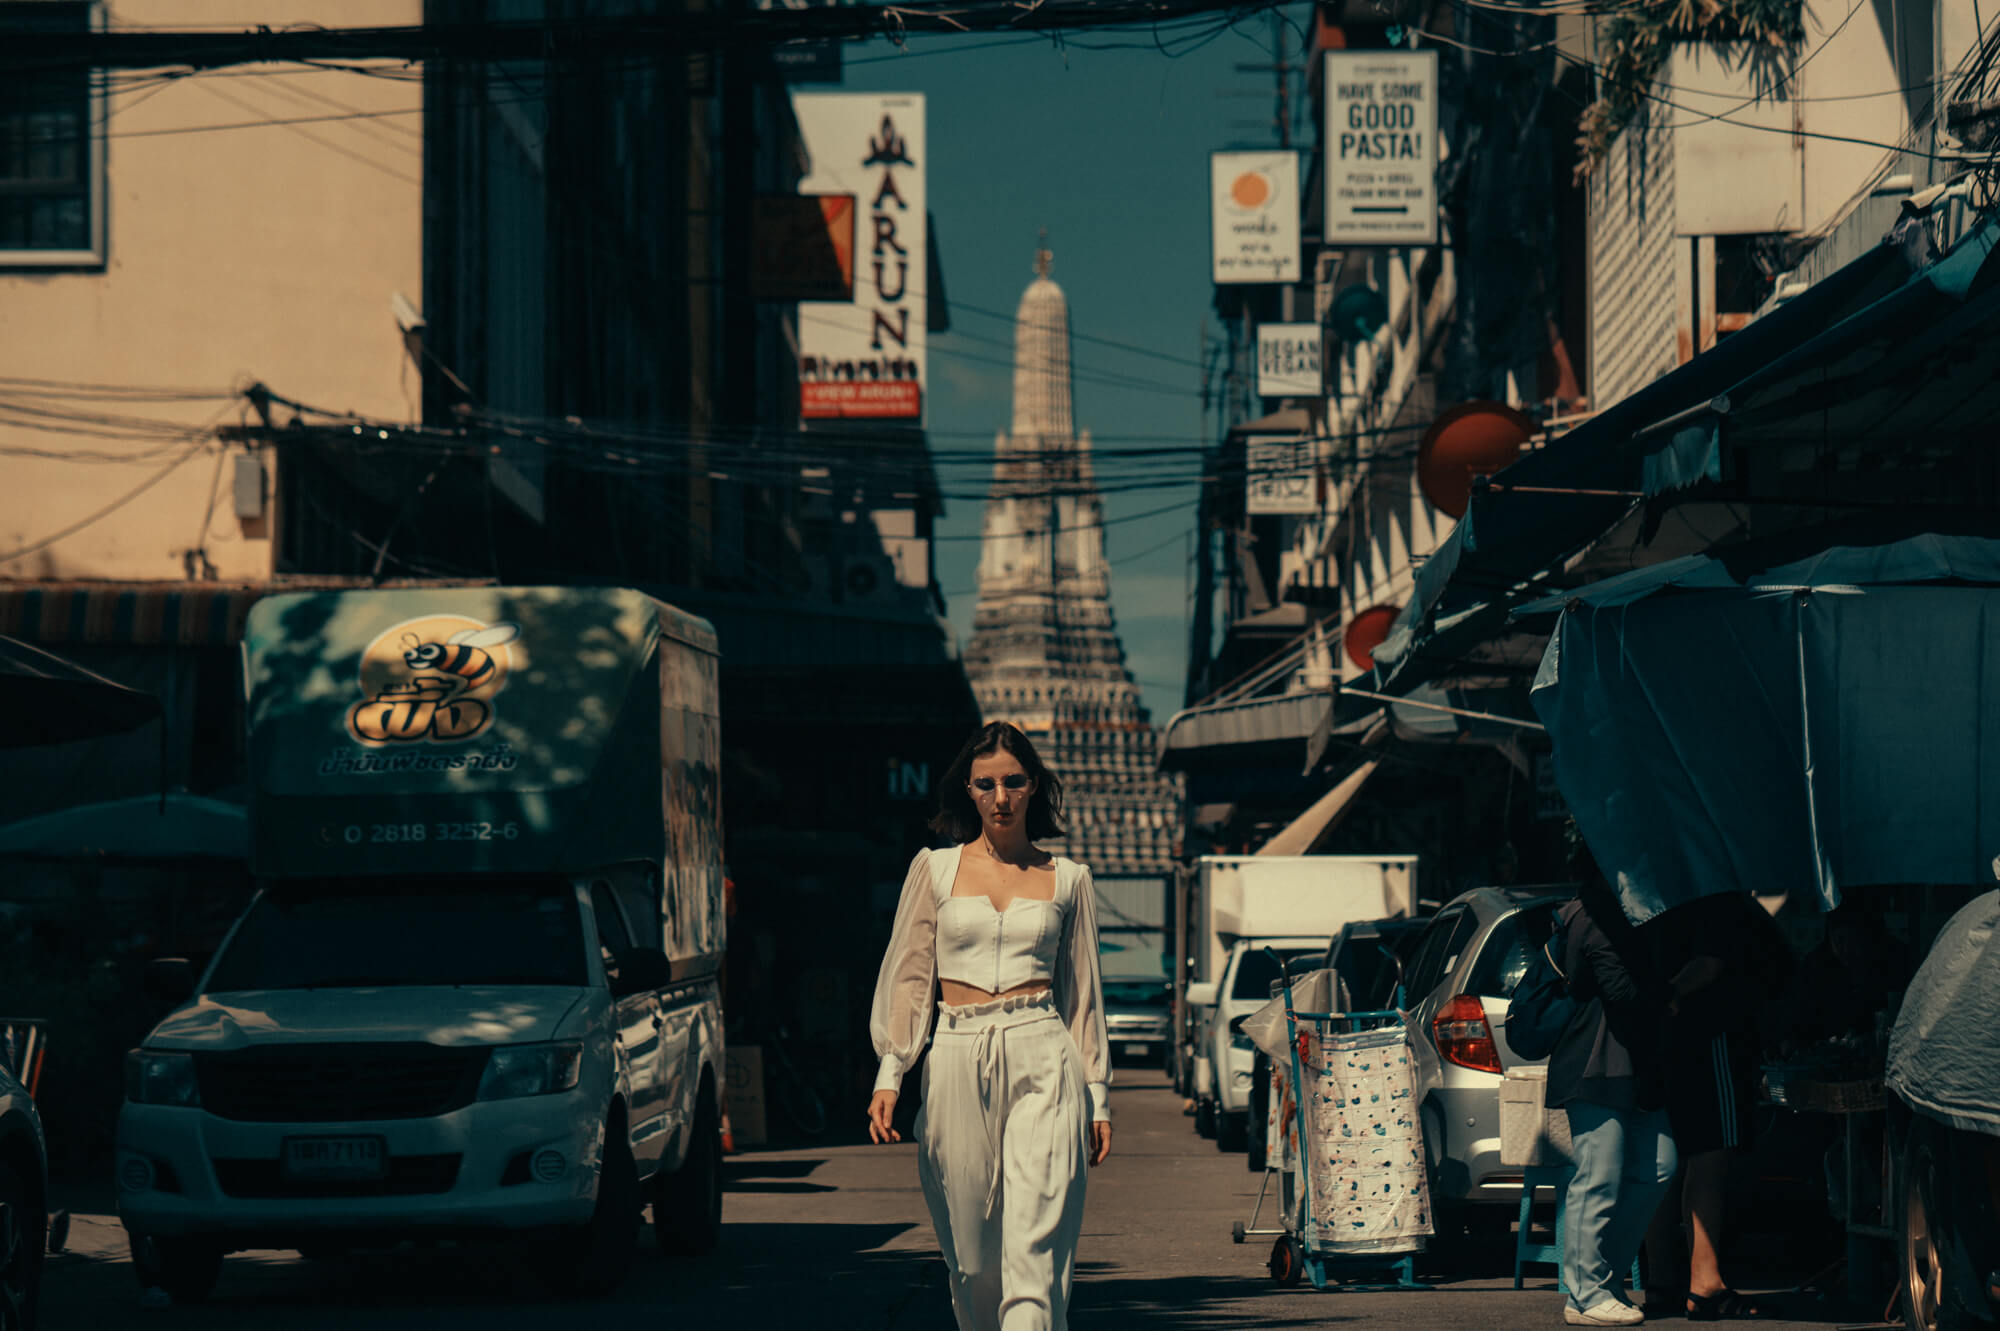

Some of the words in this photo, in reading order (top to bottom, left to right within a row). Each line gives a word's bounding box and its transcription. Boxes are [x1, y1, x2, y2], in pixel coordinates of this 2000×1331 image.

[1337, 82, 1374, 100] HAVE
[1381, 82, 1424, 100] SOME
[1348, 103, 1414, 129] GOOD
[1340, 133, 1421, 159] PASTA!
[872, 170, 908, 350] ARUN
[1263, 357, 1319, 374] VEGAN
[370, 823, 426, 843] 2818
[436, 821, 519, 841] 3252-6
